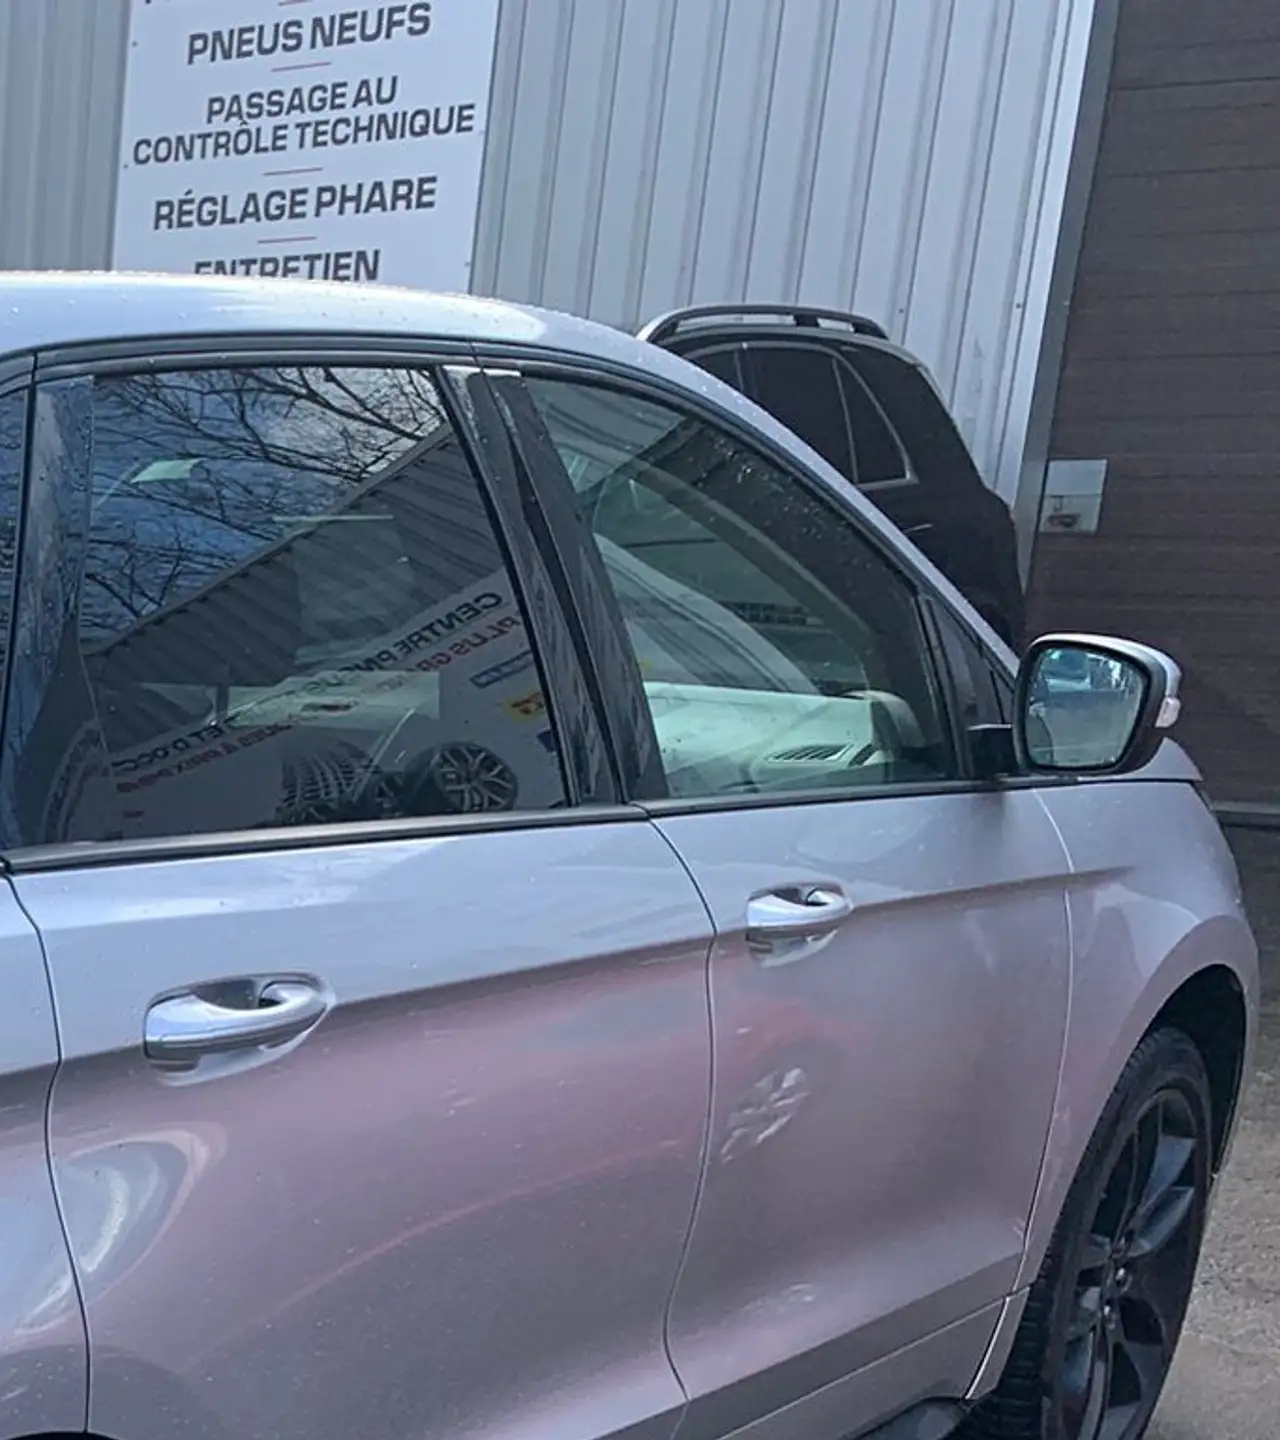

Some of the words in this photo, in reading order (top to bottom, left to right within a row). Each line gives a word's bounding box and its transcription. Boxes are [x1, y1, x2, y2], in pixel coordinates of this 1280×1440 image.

[187, 20, 303, 65] PNEUS
[309, 3, 432, 50] NEUFS
[206, 82, 348, 124] PASSAGE
[352, 75, 398, 108] AU
[133, 120, 288, 165] CONTRÔLE
[295, 104, 476, 149] TECHNIQUE
[153, 189, 309, 231] RÉGLAGE
[314, 176, 438, 218] PHARE
